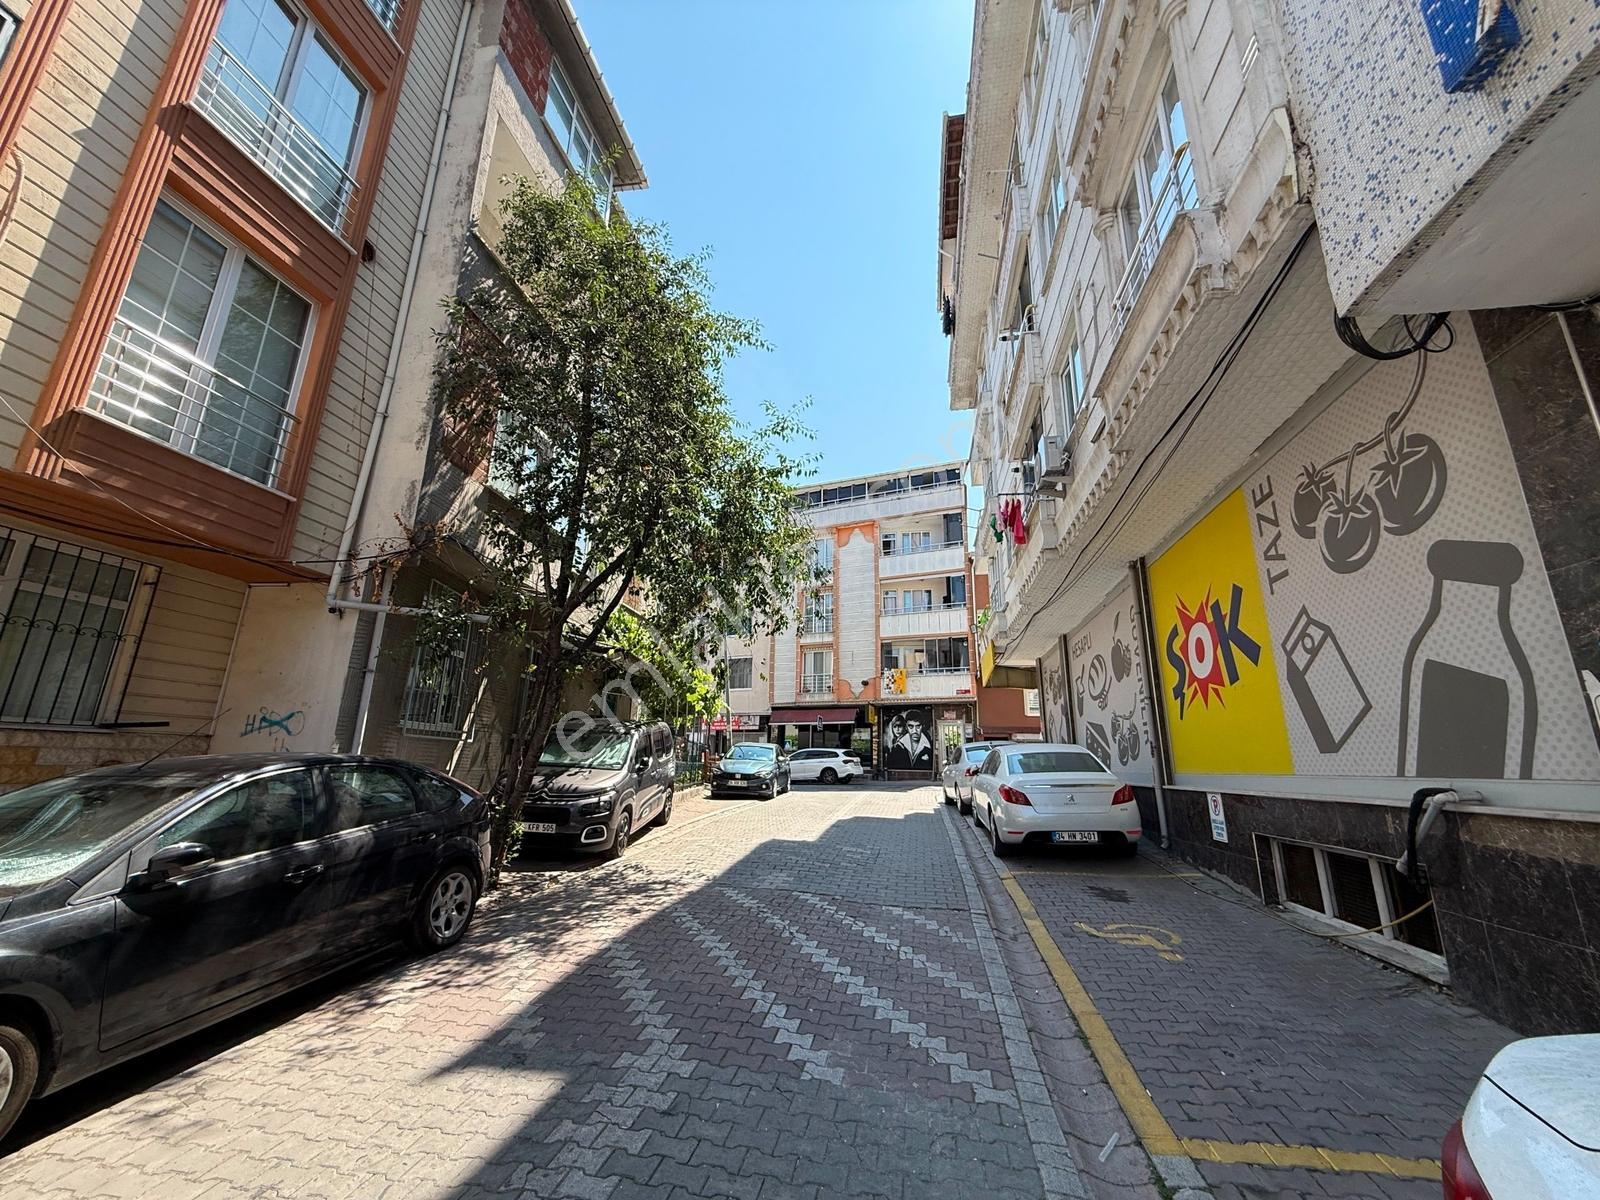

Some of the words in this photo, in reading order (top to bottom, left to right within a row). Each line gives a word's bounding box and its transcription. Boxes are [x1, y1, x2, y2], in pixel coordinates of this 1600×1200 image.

[1252, 474, 1290, 596] TAZE
[1071, 631, 1092, 661] HESAPLI
[1166, 583, 1262, 721] ŞOK
[1056, 832, 1065, 841] 34
